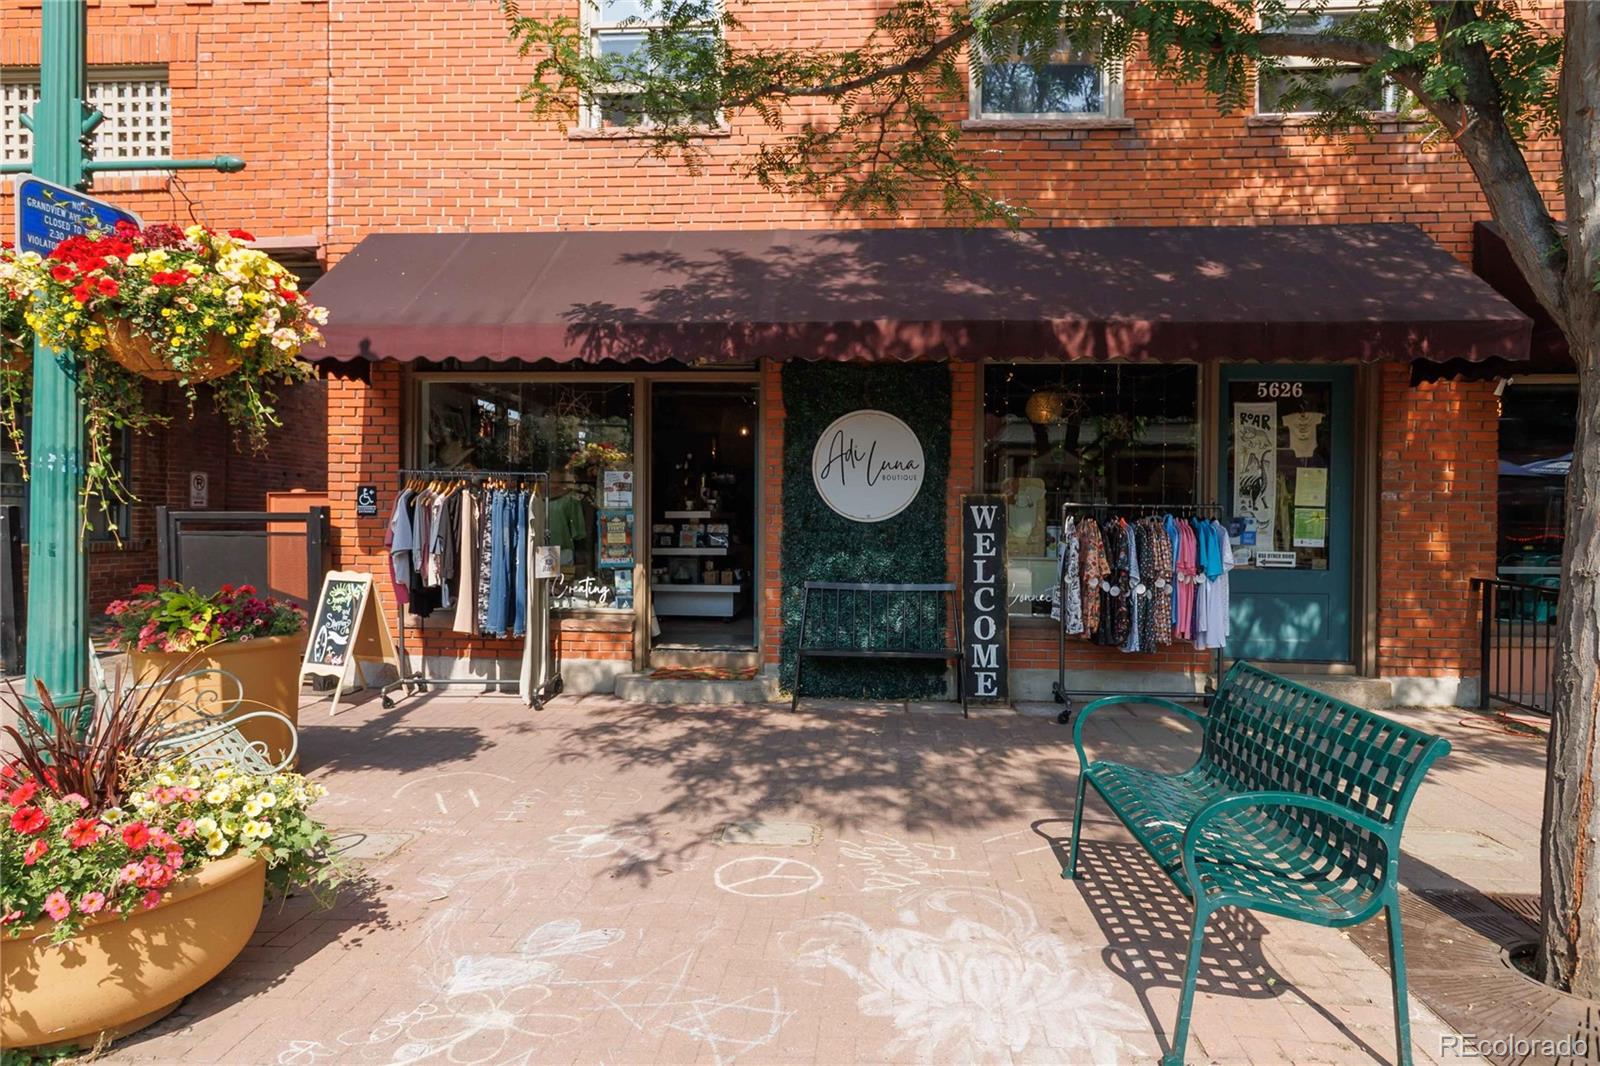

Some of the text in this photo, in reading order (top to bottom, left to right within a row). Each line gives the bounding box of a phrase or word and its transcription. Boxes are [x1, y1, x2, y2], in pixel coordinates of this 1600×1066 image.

[26, 197, 66, 218] GRANDVIEW
[72, 201, 96, 215] NOTE
[44, 215, 71, 231] CLOSED
[73, 225, 82, 235] TO
[27, 234, 60, 250] VIOLATO
[1257, 382, 1303, 398] 5626
[1240, 412, 1271, 431] ROAR
[821, 430, 920, 487] Adi Luna
[551, 573, 610, 604] Creating
[970, 505, 1000, 697] WELCOME
